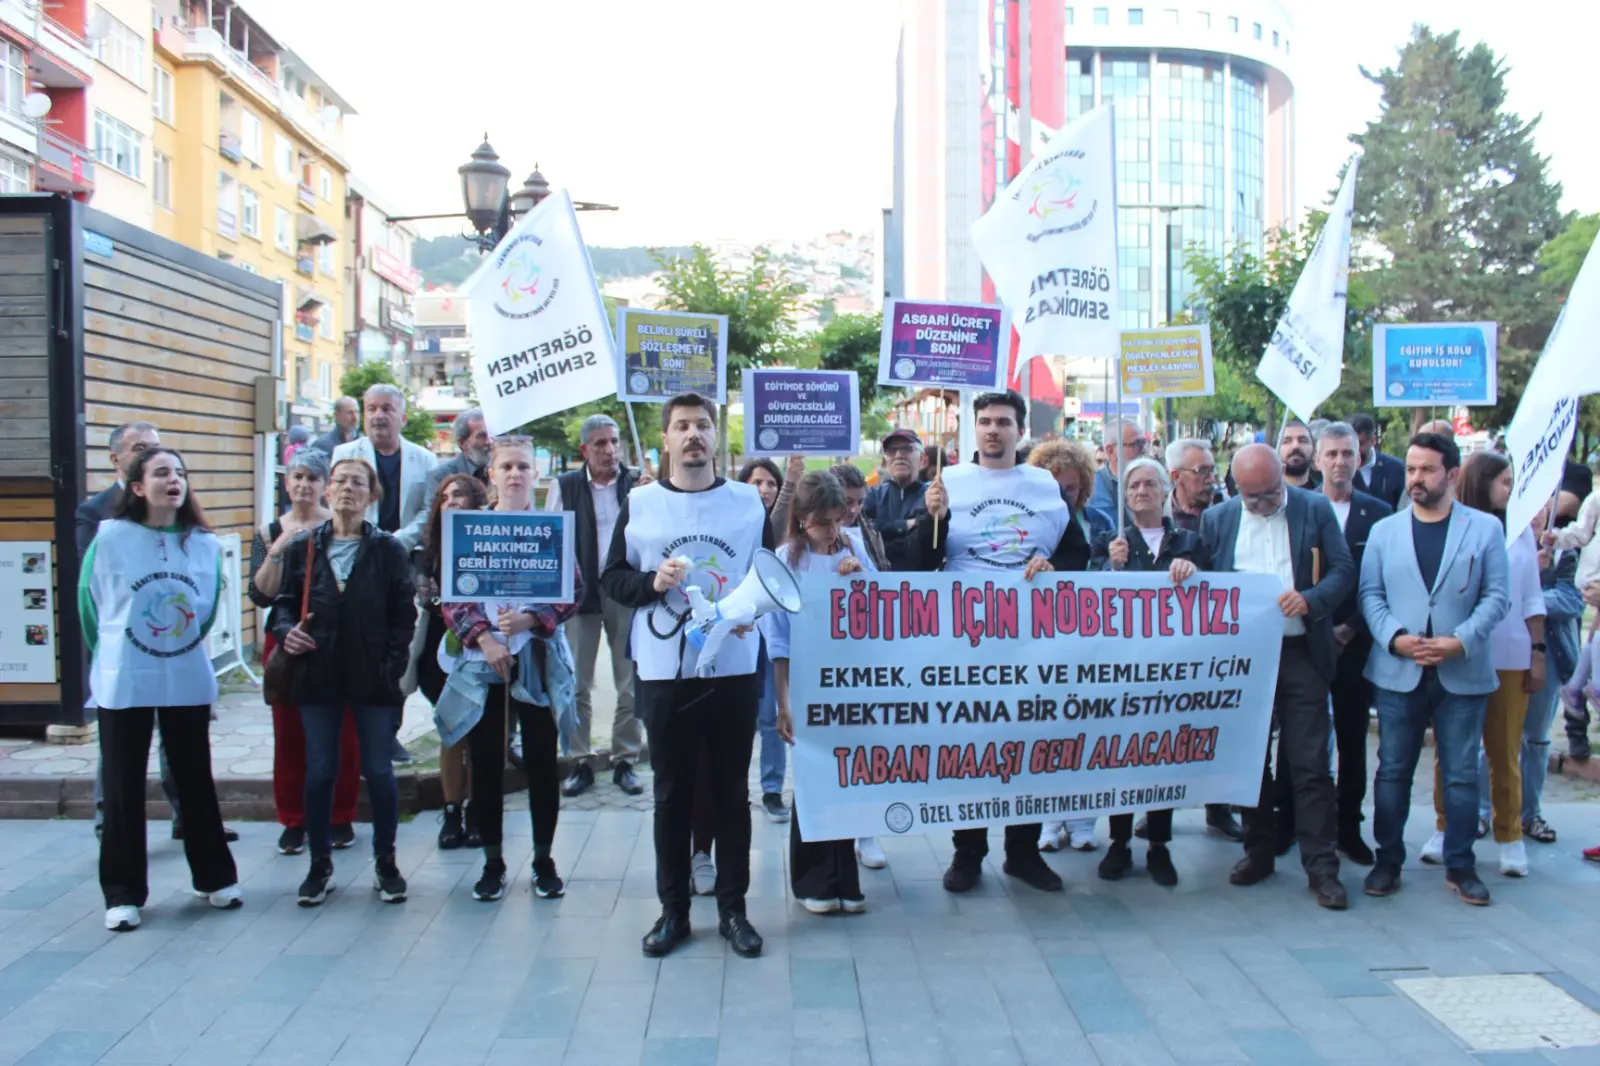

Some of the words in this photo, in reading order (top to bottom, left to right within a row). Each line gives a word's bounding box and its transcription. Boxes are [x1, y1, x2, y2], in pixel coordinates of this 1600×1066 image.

[901, 313, 949, 326] ASGARİ
[951, 314, 992, 330] ÜCRET
[915, 328, 978, 344] DÜZENİNE
[640, 339, 705, 355] SÖZLEŞMEYE
[930, 342, 961, 355] SON!
[1400, 343, 1432, 356] EĞİTİM
[1435, 343, 1445, 357] İŞ
[1447, 345, 1472, 355] KOLU
[662, 358, 685, 369] SON!
[764, 381, 805, 392] EĞİTİMDE
[805, 381, 839, 392] SÖMÜRÜ
[767, 400, 836, 411] GÜVENCESİZLİĞİ
[763, 413, 843, 424] DURDURACAĞIZ!
[464, 524, 511, 536] TABAN
[513, 525, 552, 539] MAAŞ
[473, 541, 539, 553] HAKKIMIZI
[699, 534, 737, 559] SENDİKASI
[458, 555, 486, 568] GERİ
[488, 556, 558, 570] İSTİYORUZ!
[830, 580, 939, 640] EĞİTİM
[952, 581, 1018, 647] İÇİN
[1031, 581, 1241, 638] NÖBETTEYİZ!
[820, 666, 912, 688] EKMEK,
[920, 665, 1029, 686] GELECEK
[1037, 664, 1068, 684] VE
[1076, 661, 1203, 683] MEMLEKET
[1208, 655, 1251, 682] İÇİN
[807, 702, 929, 726] EMEKTEN
[935, 701, 1011, 723] YANA
[1017, 694, 1058, 721] BİR
[1062, 694, 1117, 720] ÖMK
[1120, 689, 1242, 717] İSTİYORUZ!
[833, 745, 930, 787] TABAN
[936, 741, 1025, 784] MAAŞI
[1029, 732, 1086, 775] GERİ
[1087, 723, 1219, 770] ALACAĞIZ!
[919, 803, 953, 824] ÖZEL
[958, 798, 1010, 821] SEKTÖR
[1015, 788, 1116, 816] ÖĞRETMENLERİ
[1120, 785, 1187, 806] SENDİKASI
